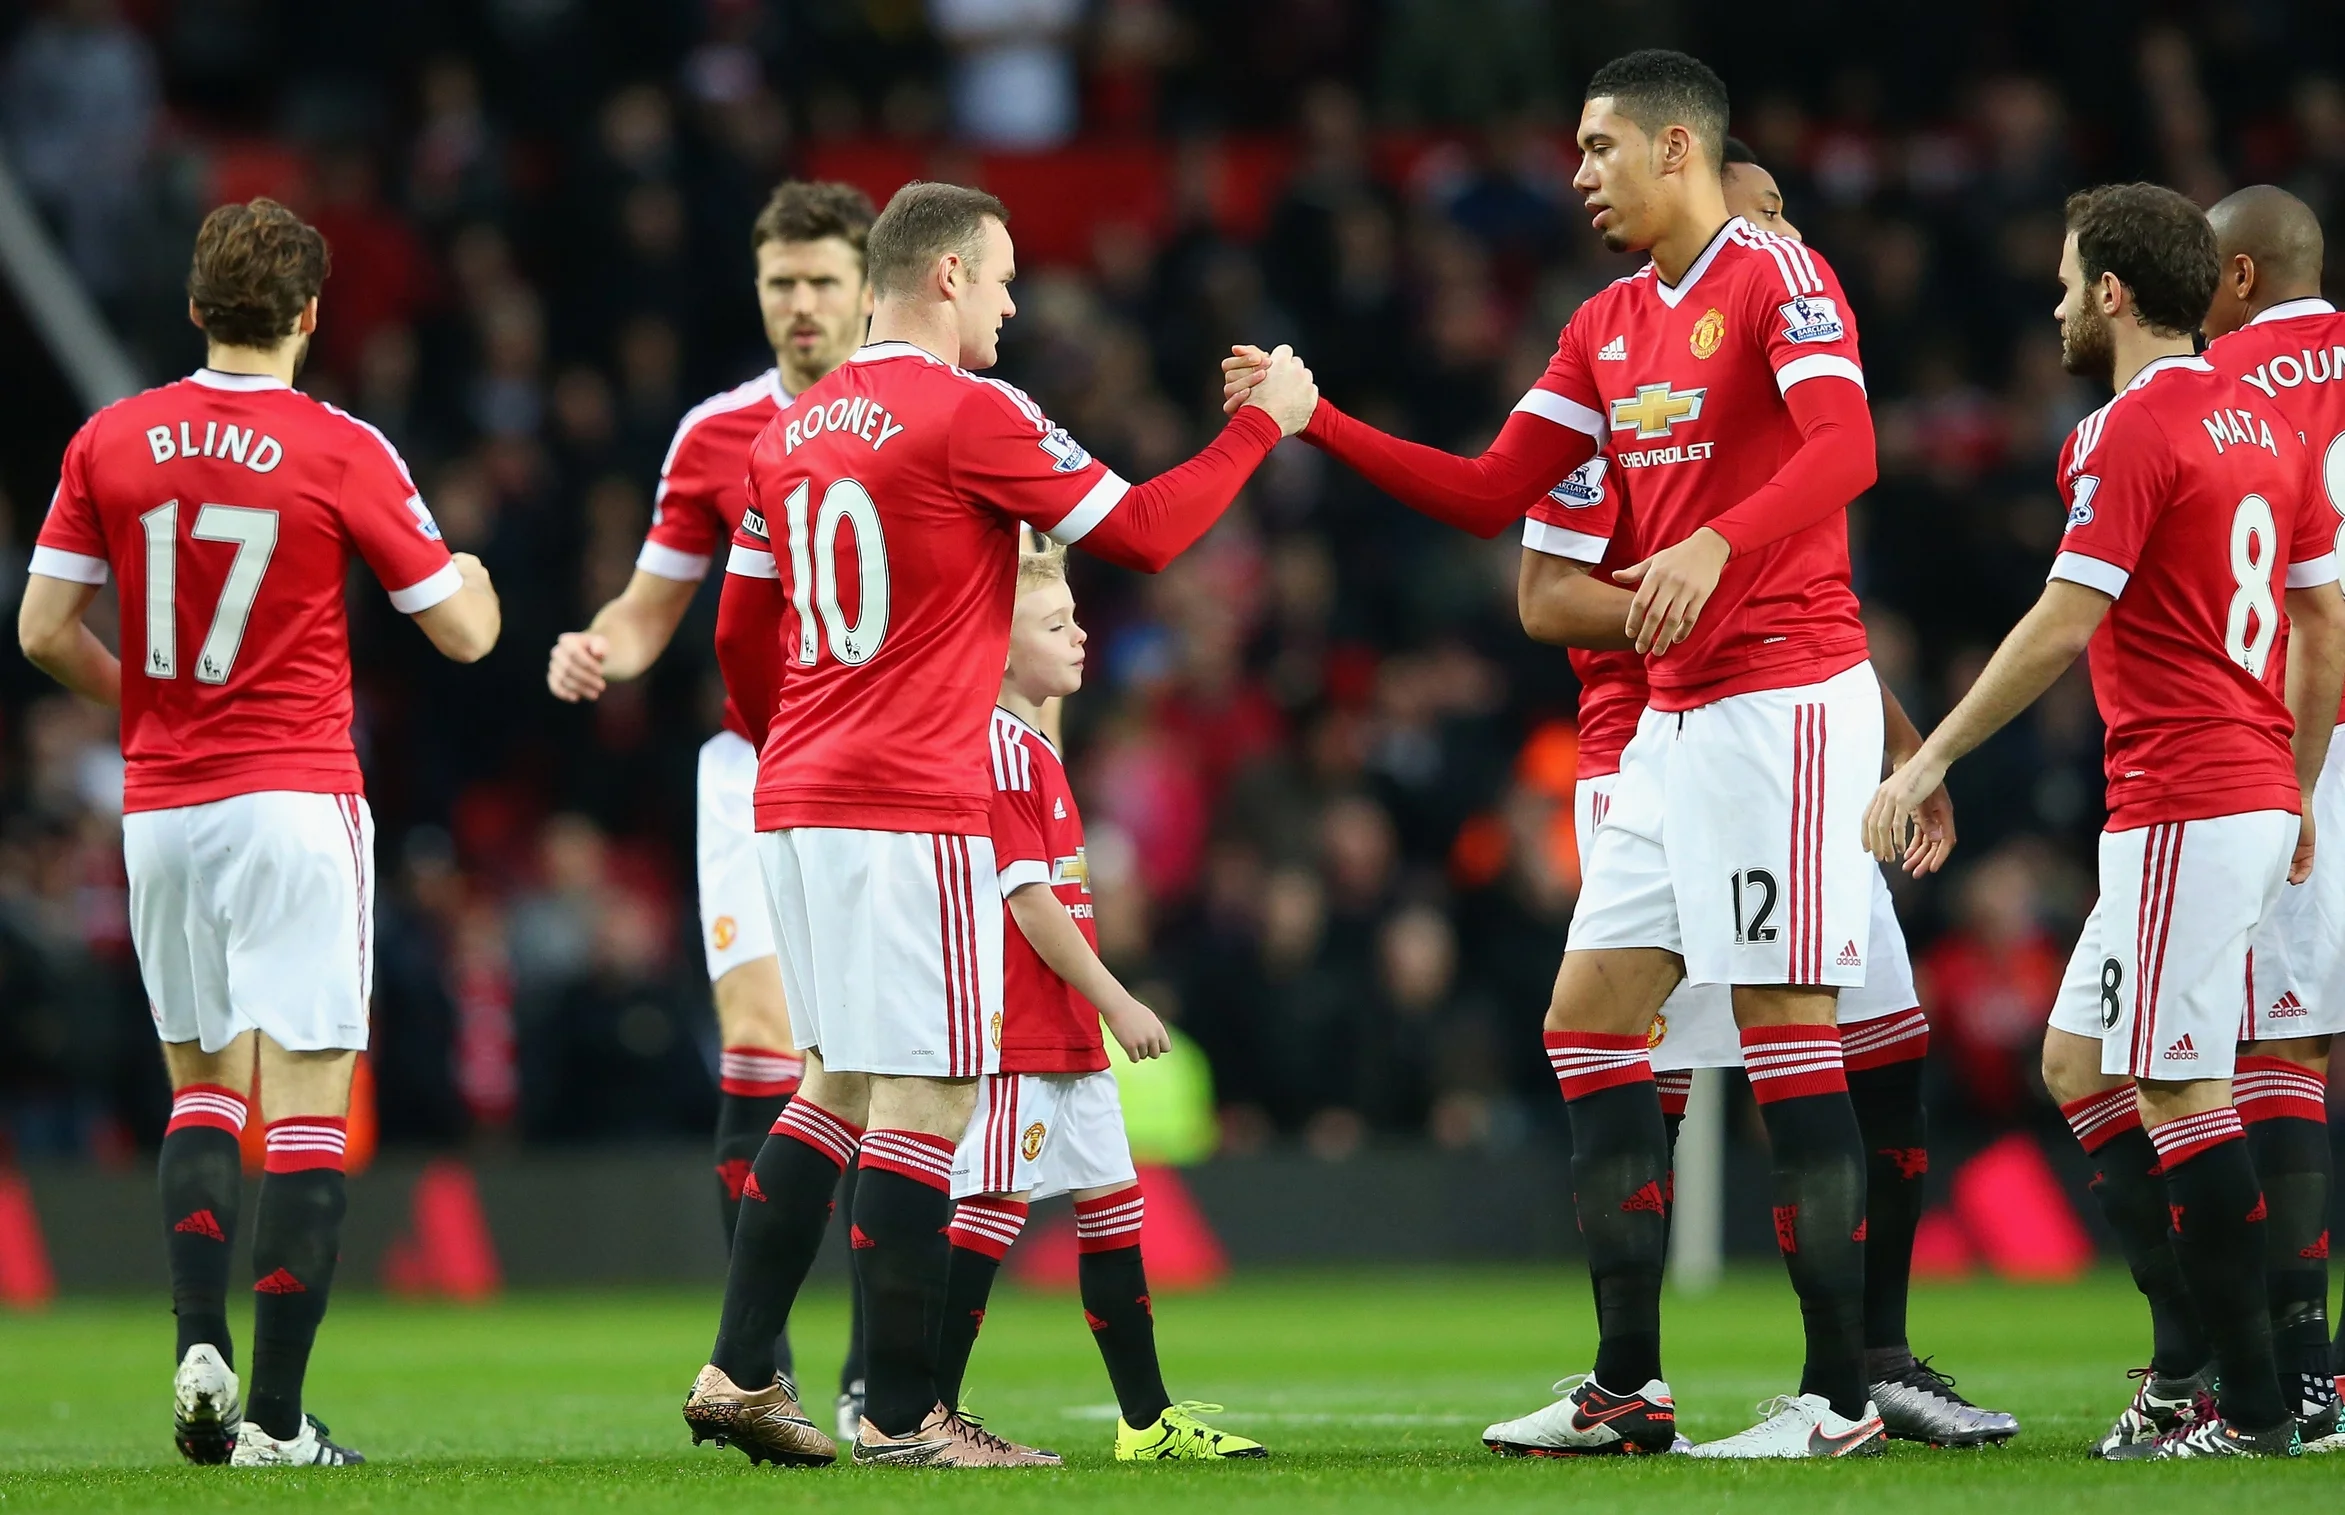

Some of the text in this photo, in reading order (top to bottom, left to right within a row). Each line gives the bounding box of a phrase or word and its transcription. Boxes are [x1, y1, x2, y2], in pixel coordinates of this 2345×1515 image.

[146, 420, 283, 474] BLIND
[784, 397, 904, 456] ROONEY
[2201, 408, 2279, 457] MATA
[1618, 442, 1715, 469] CHEVROLET
[1558, 483, 1588, 494] ARCLAYS
[139, 498, 280, 685] 17
[784, 477, 890, 667] 10
[2225, 493, 2279, 682] 8
[1730, 867, 1781, 945] 12
[1836, 957, 1861, 967] adidas
[2101, 954, 2125, 1032] 8
[2268, 1006, 2308, 1018] adidas
[2164, 1050, 2199, 1060] adidas
